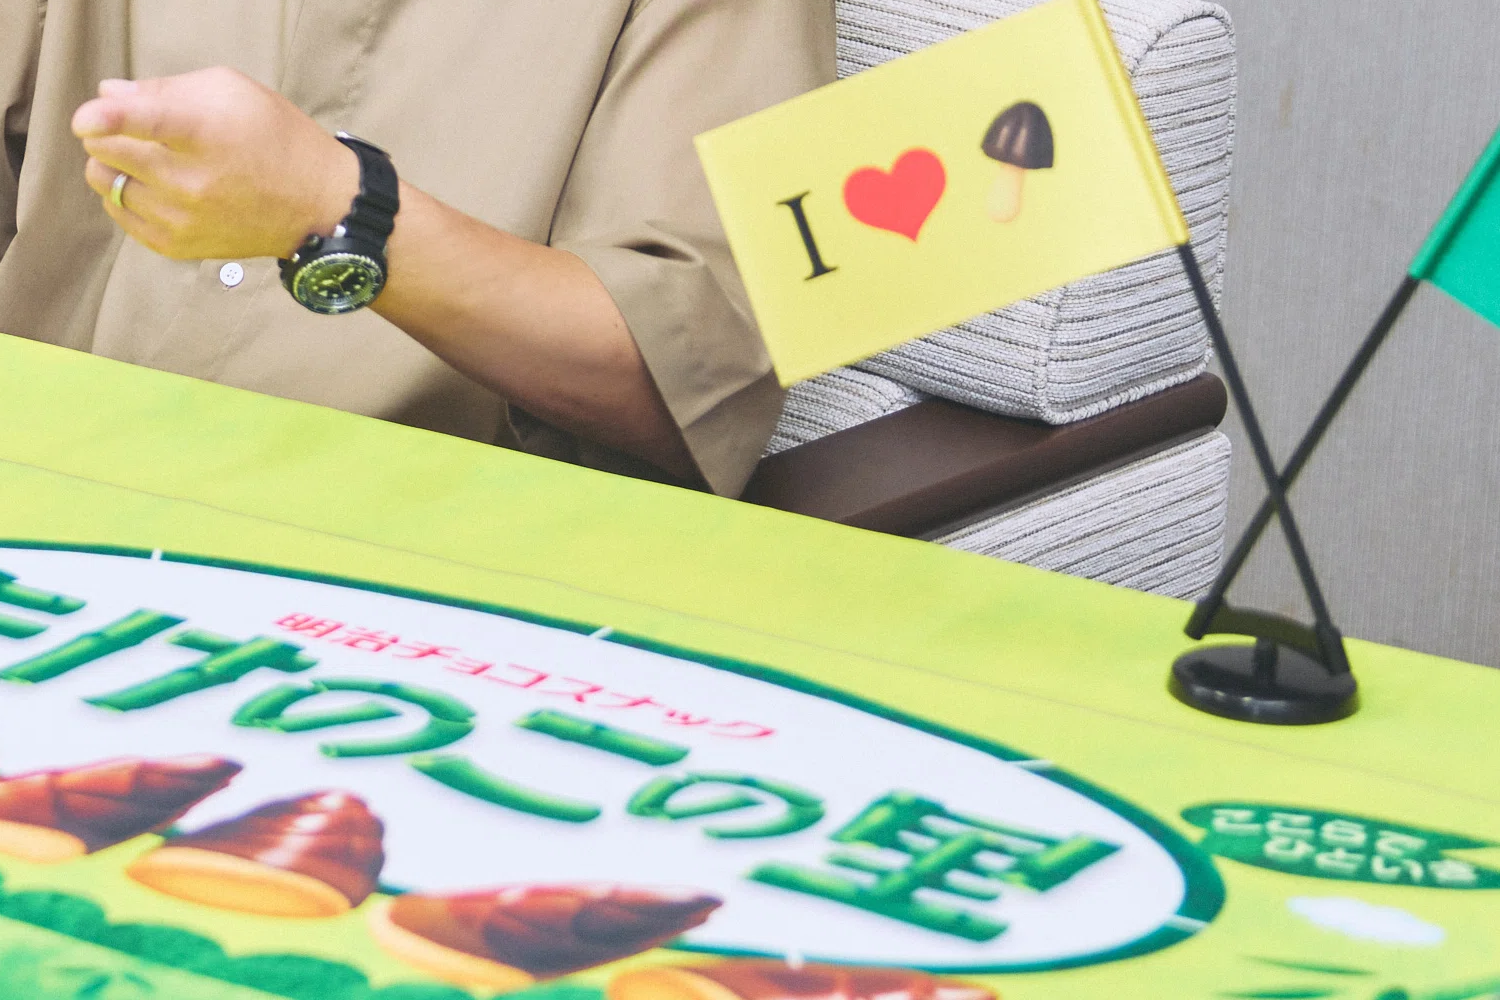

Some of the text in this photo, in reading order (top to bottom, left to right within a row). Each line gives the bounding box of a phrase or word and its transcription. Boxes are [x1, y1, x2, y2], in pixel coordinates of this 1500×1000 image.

[777, 191, 839, 281] I
[273, 612, 777, 739] 明治チョコスナック
